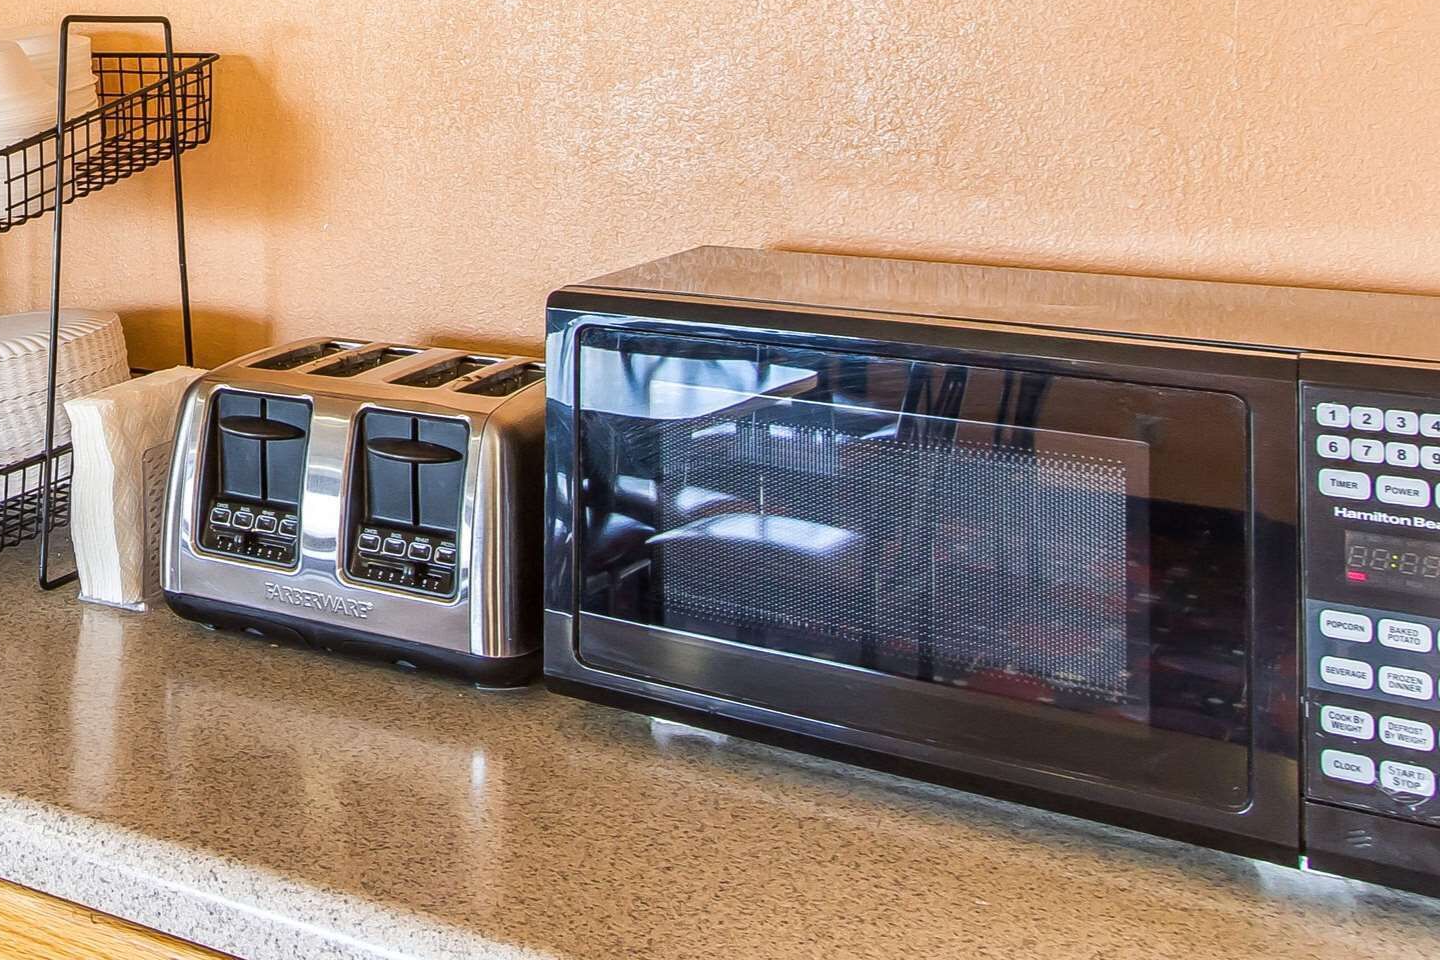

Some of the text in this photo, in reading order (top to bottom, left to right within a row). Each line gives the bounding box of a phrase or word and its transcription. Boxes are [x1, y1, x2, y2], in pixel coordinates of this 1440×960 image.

[1328, 409, 1440, 432] 1 2 3 4
[1328, 441, 1440, 465] 6 7 8 9
[1329, 477, 1359, 489] TIMER
[1384, 484, 1420, 497] POWER
[1333, 506, 1412, 527] Hamilton
[1325, 619, 1365, 633] POPCORN
[1388, 625, 1420, 637] BAKED
[1387, 633, 1421, 646] POTATO
[1325, 665, 1368, 680] BEVERAGE
[1386, 672, 1423, 685] FROZEN
[1388, 680, 1422, 693] DINNER
[1327, 710, 1352, 723] COOK
[1331, 720, 1363, 733] WEIGHT
[1397, 732, 1427, 745] WEIGHT
[1332, 759, 1362, 773] CLOCK
[1391, 776, 1422, 790] STOP
